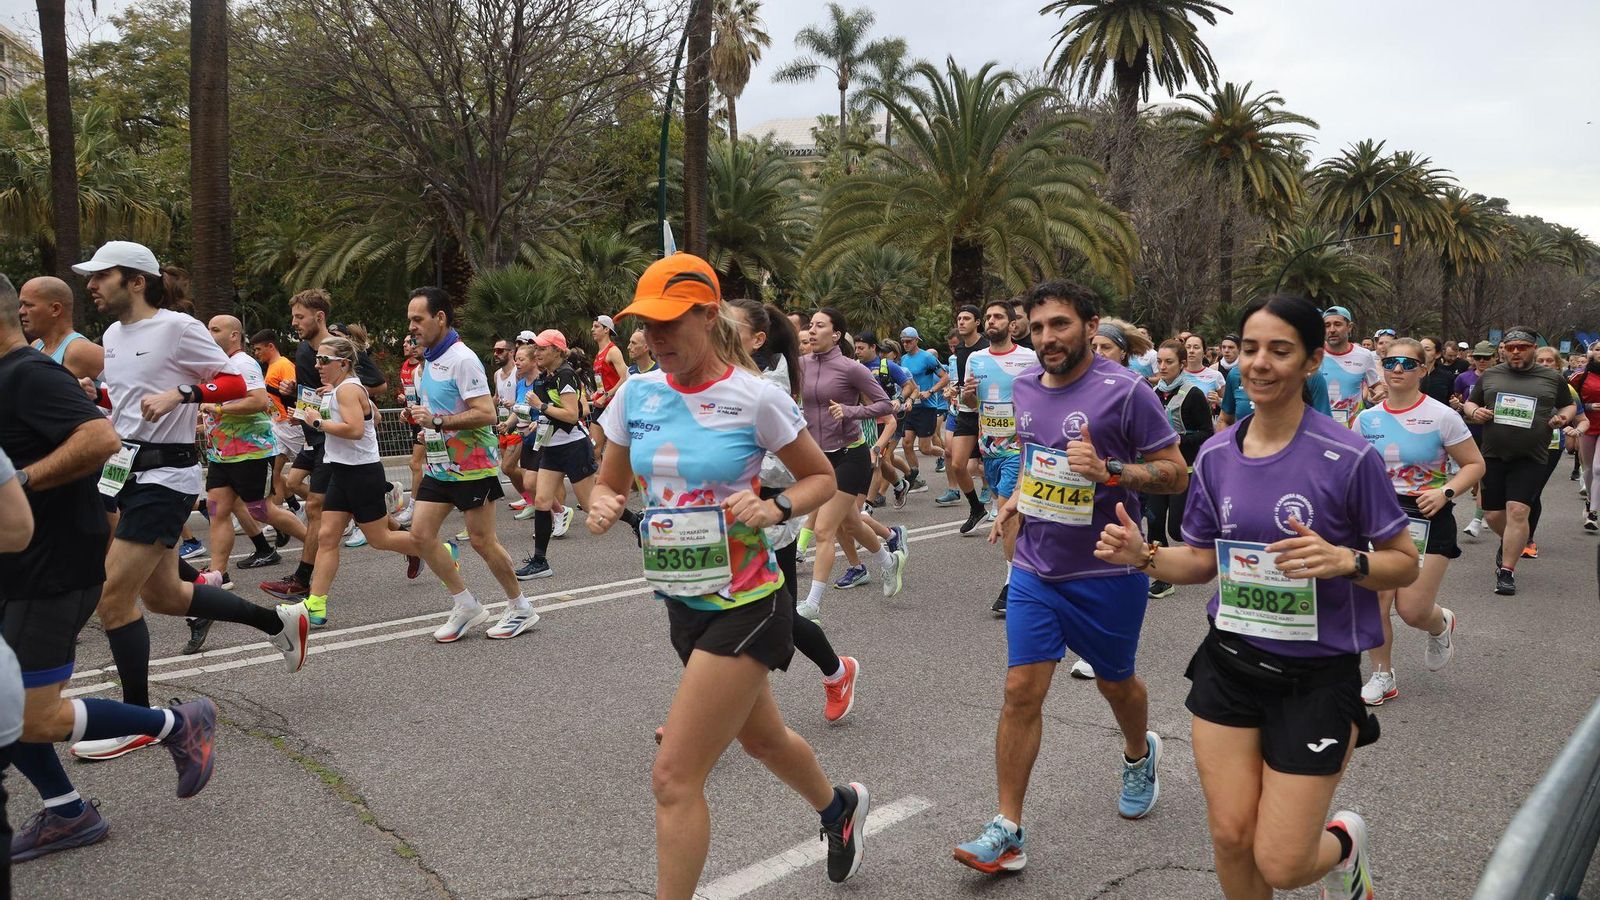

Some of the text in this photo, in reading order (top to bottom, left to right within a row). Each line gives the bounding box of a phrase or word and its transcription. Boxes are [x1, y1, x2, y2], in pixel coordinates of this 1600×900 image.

[986, 418, 1009, 428] 2548
[1502, 407, 1528, 418] 4435
[1032, 481, 1081, 506] 2714
[657, 546, 711, 570] 5367
[1236, 586, 1297, 615] 5982
